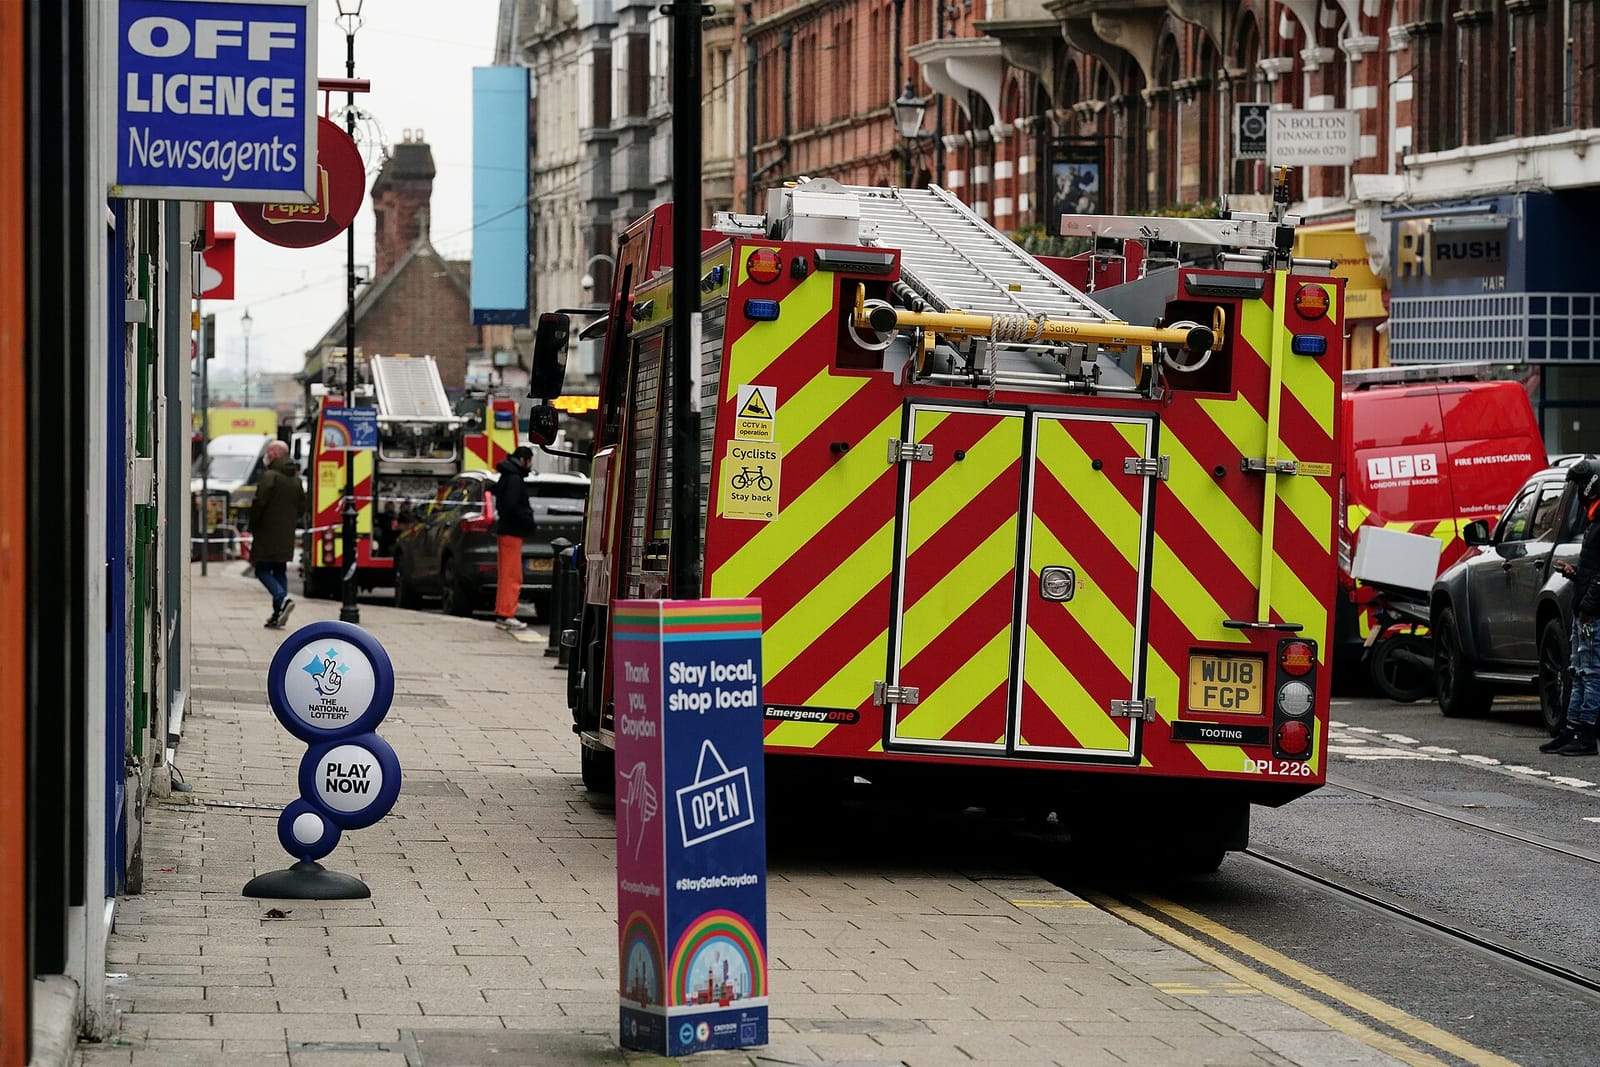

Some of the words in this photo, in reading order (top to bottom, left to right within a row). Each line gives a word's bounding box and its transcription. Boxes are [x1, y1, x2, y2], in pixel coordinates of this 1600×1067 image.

[128, 16, 297, 61] OFF
[126, 73, 296, 118] LICENCE
[1277, 117, 1287, 129] N
[1291, 116, 1346, 129] BOLTON
[1277, 131, 1323, 141] FINANCE
[1326, 130, 1346, 140] LTD
[128, 126, 297, 181] Newsagents
[1277, 146, 1295, 156] 020
[1322, 145, 1346, 156] 0270
[1437, 241, 1501, 261] RUSH
[1481, 275, 1505, 291] HAIR
[1049, 323, 1079, 334] Safety
[739, 429, 769, 437] operation
[742, 421, 759, 429] CCTV
[732, 447, 777, 461] Cyclists
[1454, 457, 1472, 467] FIRE
[1473, 454, 1532, 466] INVESTIGATION
[1370, 480, 1397, 490] LONDON
[1398, 479, 1411, 488] FIRE
[1412, 478, 1439, 487] BRIGADE
[730, 492, 749, 502] Stay
[751, 493, 772, 502] back
[624, 660, 650, 683] Thank
[669, 660, 707, 687] Stay
[710, 659, 757, 684] local,
[1202, 660, 1254, 684] WU18
[320, 698, 337, 706] THE
[628, 693, 647, 713] you,
[669, 688, 712, 714] shop
[715, 686, 758, 709] local
[1203, 686, 1250, 708] FGP
[308, 704, 349, 713] NATIONAL
[310, 711, 347, 720] LOTTERY
[765, 707, 828, 721] Emergency
[828, 711, 855, 721] one
[621, 715, 656, 740] Croydon
[1200, 728, 1243, 739] TOOTING
[326, 763, 371, 779] PLAY
[1243, 759, 1311, 776] DPL226
[325, 778, 370, 794] NOW
[692, 782, 741, 829] OPEN
[675, 873, 759, 892] #StaySafeCroydon
